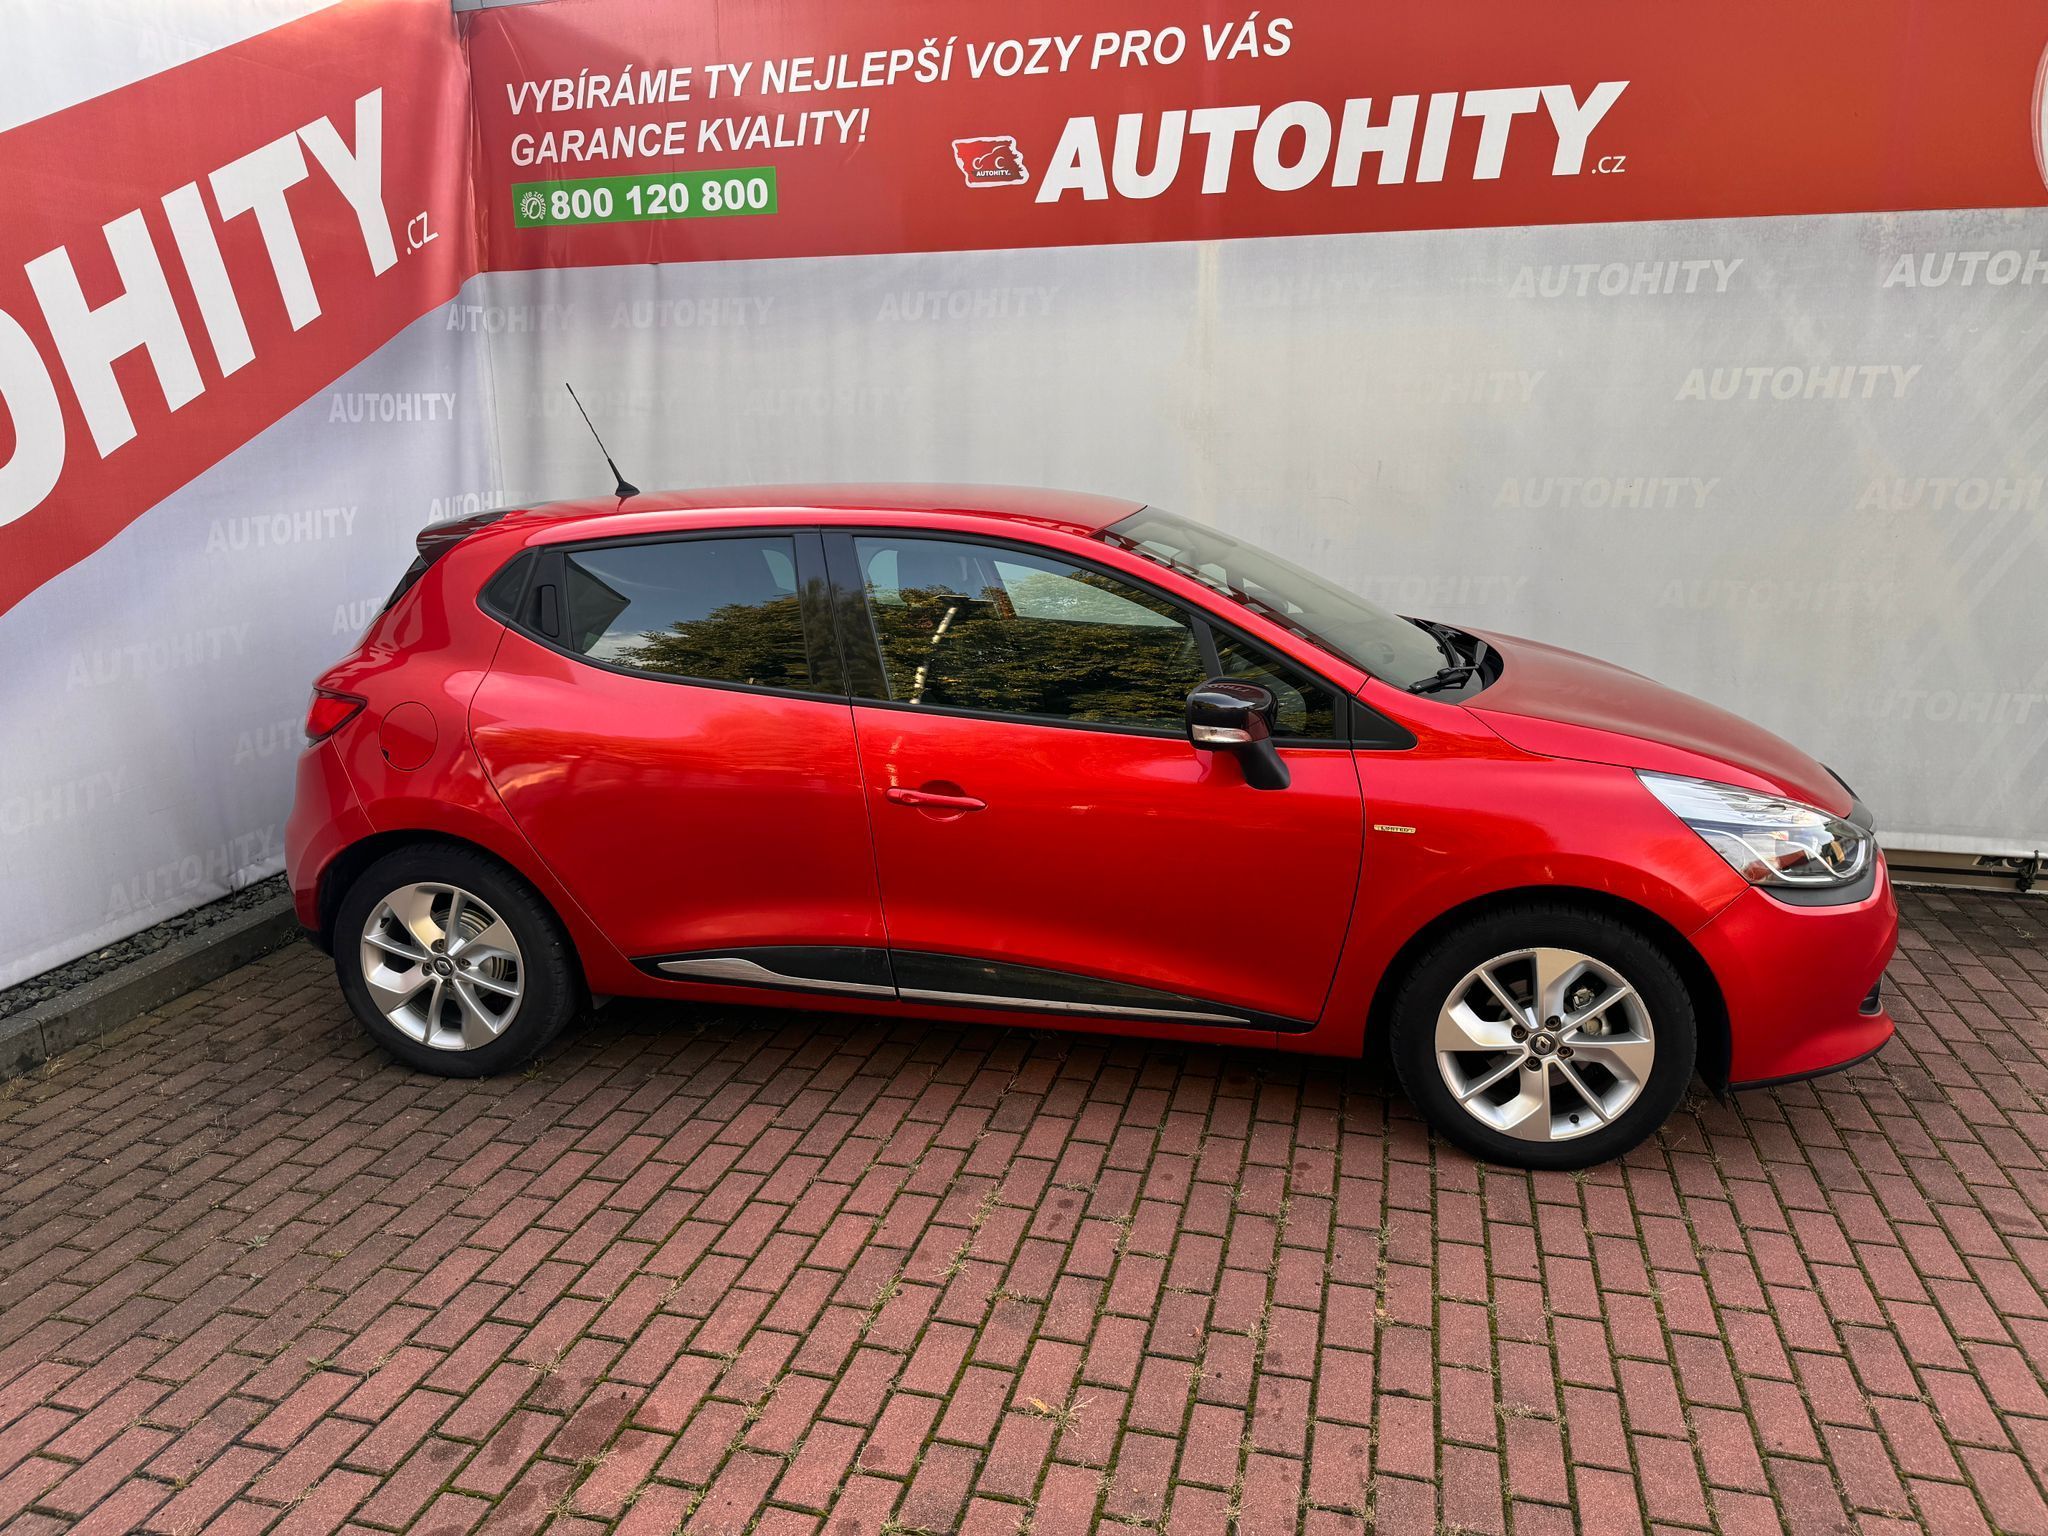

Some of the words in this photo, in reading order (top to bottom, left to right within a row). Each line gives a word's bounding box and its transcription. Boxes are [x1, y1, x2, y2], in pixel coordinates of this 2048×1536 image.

[506, 64, 692, 115] VYBÍRÁME
[704, 62, 753, 99] TY
[761, 36, 958, 95] NEJLEPŠÍ
[966, 35, 1083, 80] VOZY
[1090, 26, 1186, 70] PRO
[1201, 11, 1294, 61] VÁS
[511, 121, 686, 167] GARANCE
[698, 108, 870, 153] KVALITY!
[551, 187, 613, 220] 800
[626, 183, 689, 216] 120
[701, 178, 768, 211] 800
[1507, 258, 1744, 298] AUTOHITY
[611, 296, 775, 329] AUTOHITY
[876, 286, 1060, 321] AUTOHITY
[1675, 365, 1922, 401] AUTOHITY
[328, 392, 456, 423] AUTOHITY
[1492, 476, 1721, 509] AUTOHITY
[204, 506, 358, 552] AUTOHITY
[65, 621, 250, 692] AUTOHITY
